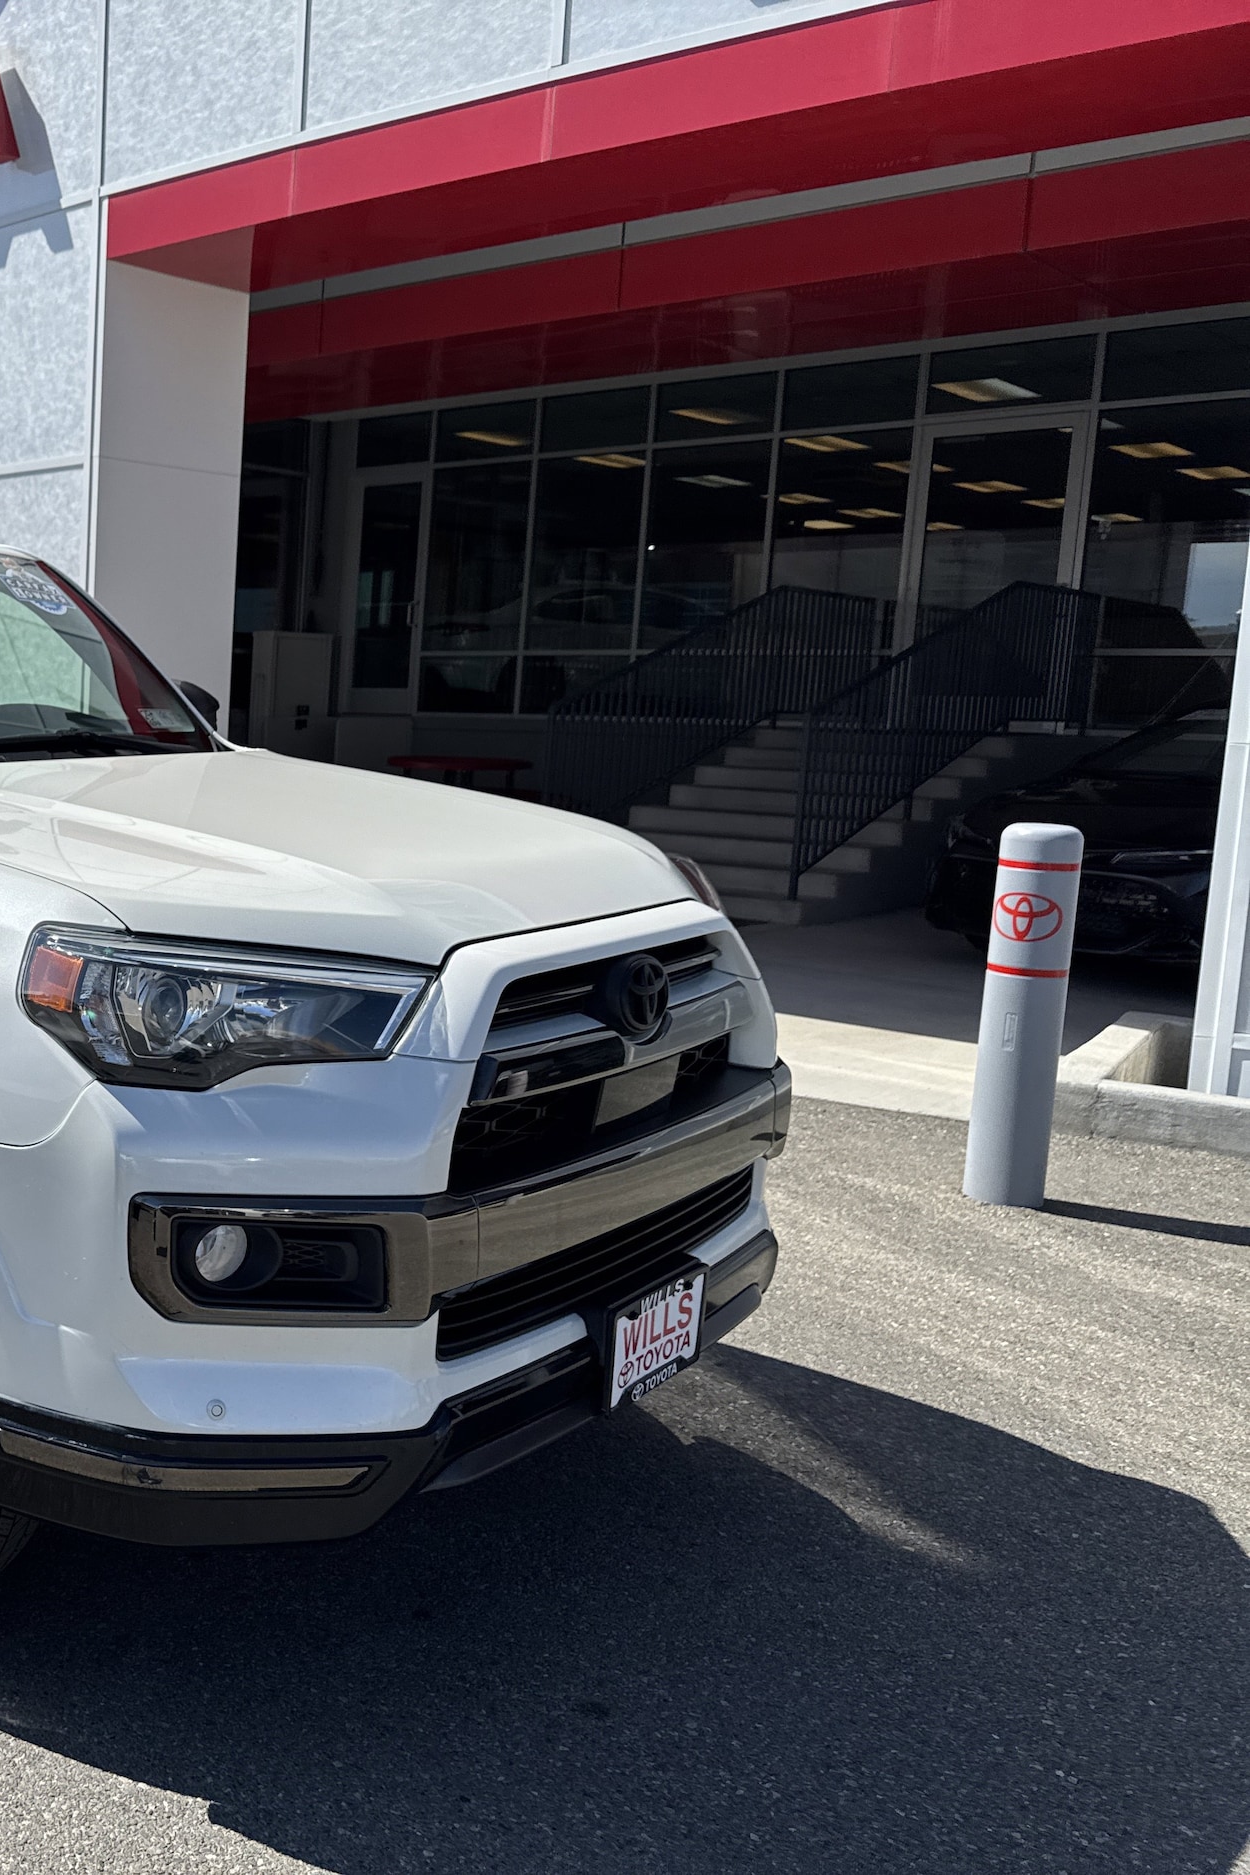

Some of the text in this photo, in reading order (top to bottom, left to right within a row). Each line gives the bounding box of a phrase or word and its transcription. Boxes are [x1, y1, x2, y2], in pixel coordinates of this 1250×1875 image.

[641, 1278, 685, 1314] WILLS
[623, 1292, 693, 1360] WILLS
[636, 1330, 690, 1376] TOYOTA
[644, 1362, 678, 1391] TOYOTA
